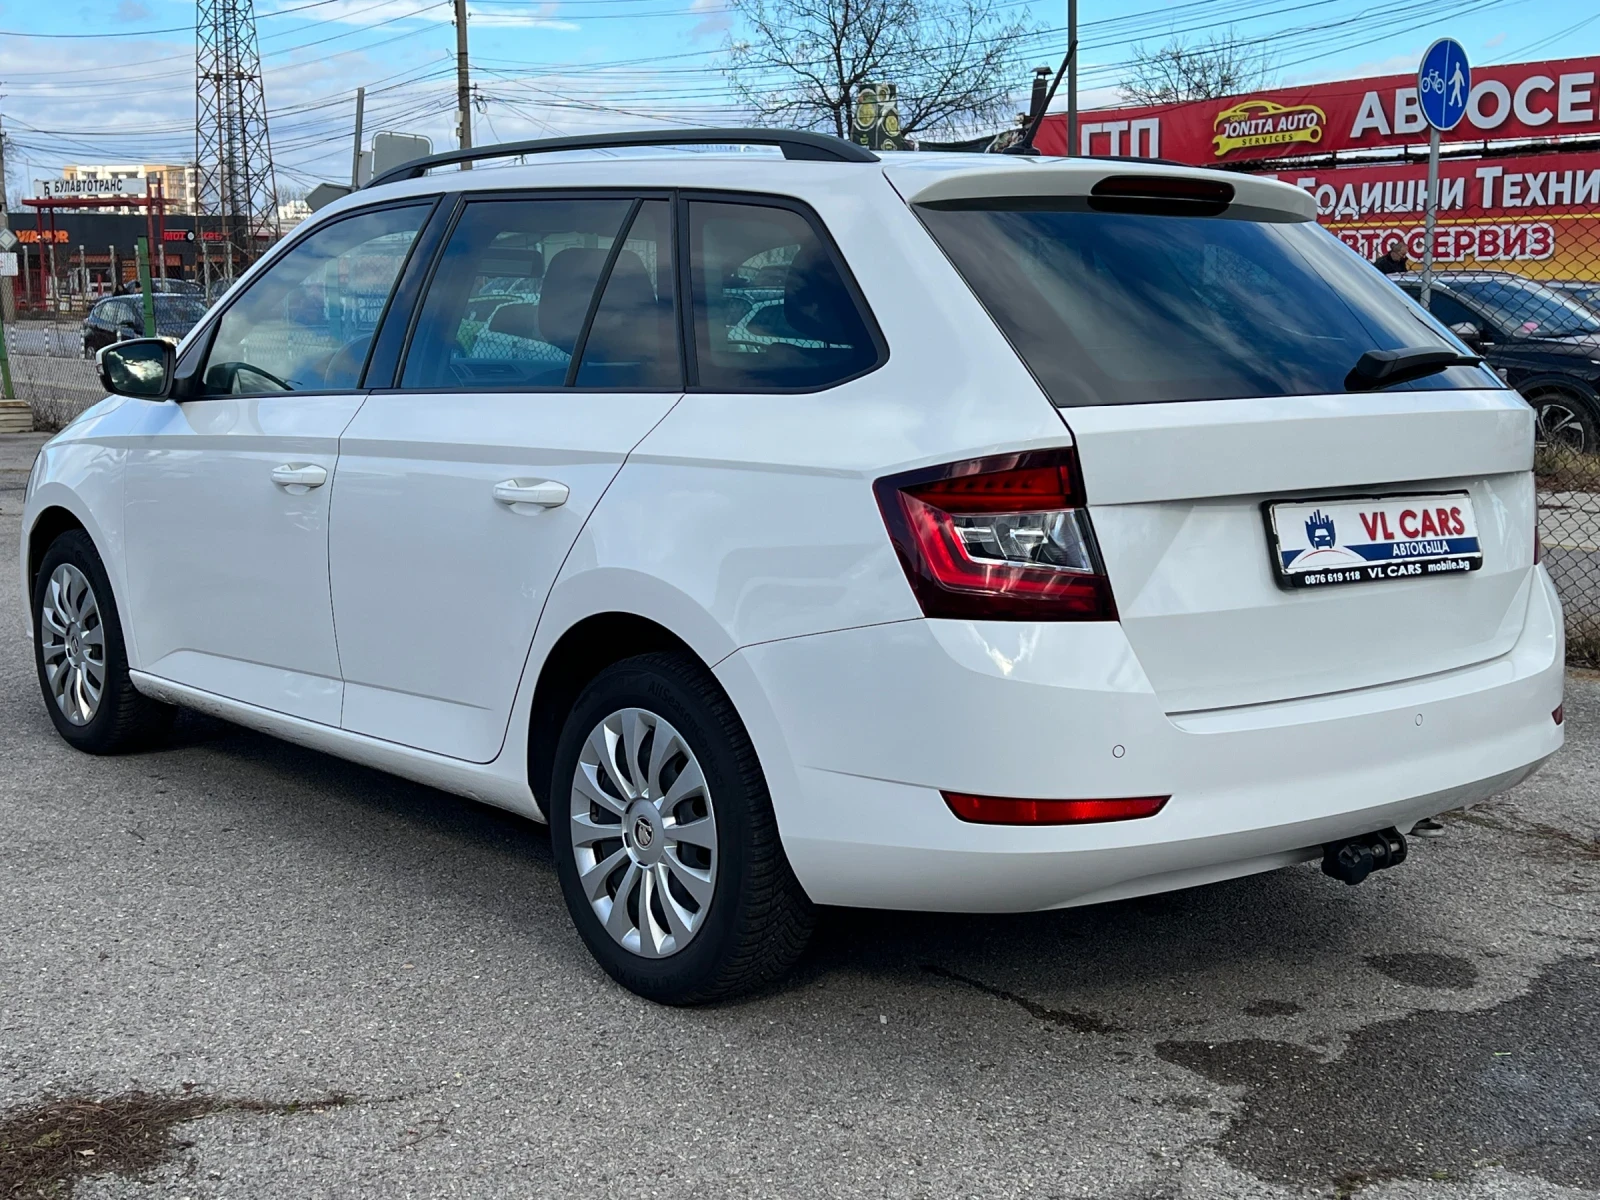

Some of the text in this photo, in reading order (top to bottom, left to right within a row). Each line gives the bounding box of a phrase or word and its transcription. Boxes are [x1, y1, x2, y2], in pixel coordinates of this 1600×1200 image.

[1349, 72, 1600, 138] АВОСЕ
[1222, 112, 1318, 138] JONITA AUTO
[1241, 133, 1294, 146] SERVICES
[54, 179, 123, 193] БУЛАВТОТРАНС
[1337, 222, 1554, 263] ВТОСЕРВИЗ
[1359, 506, 1465, 541] VL CARS
[1392, 540, 1450, 557] АВТОКЪЩА
[1304, 559, 1470, 585] 0876 619 118 VL CARS mobile.bg
